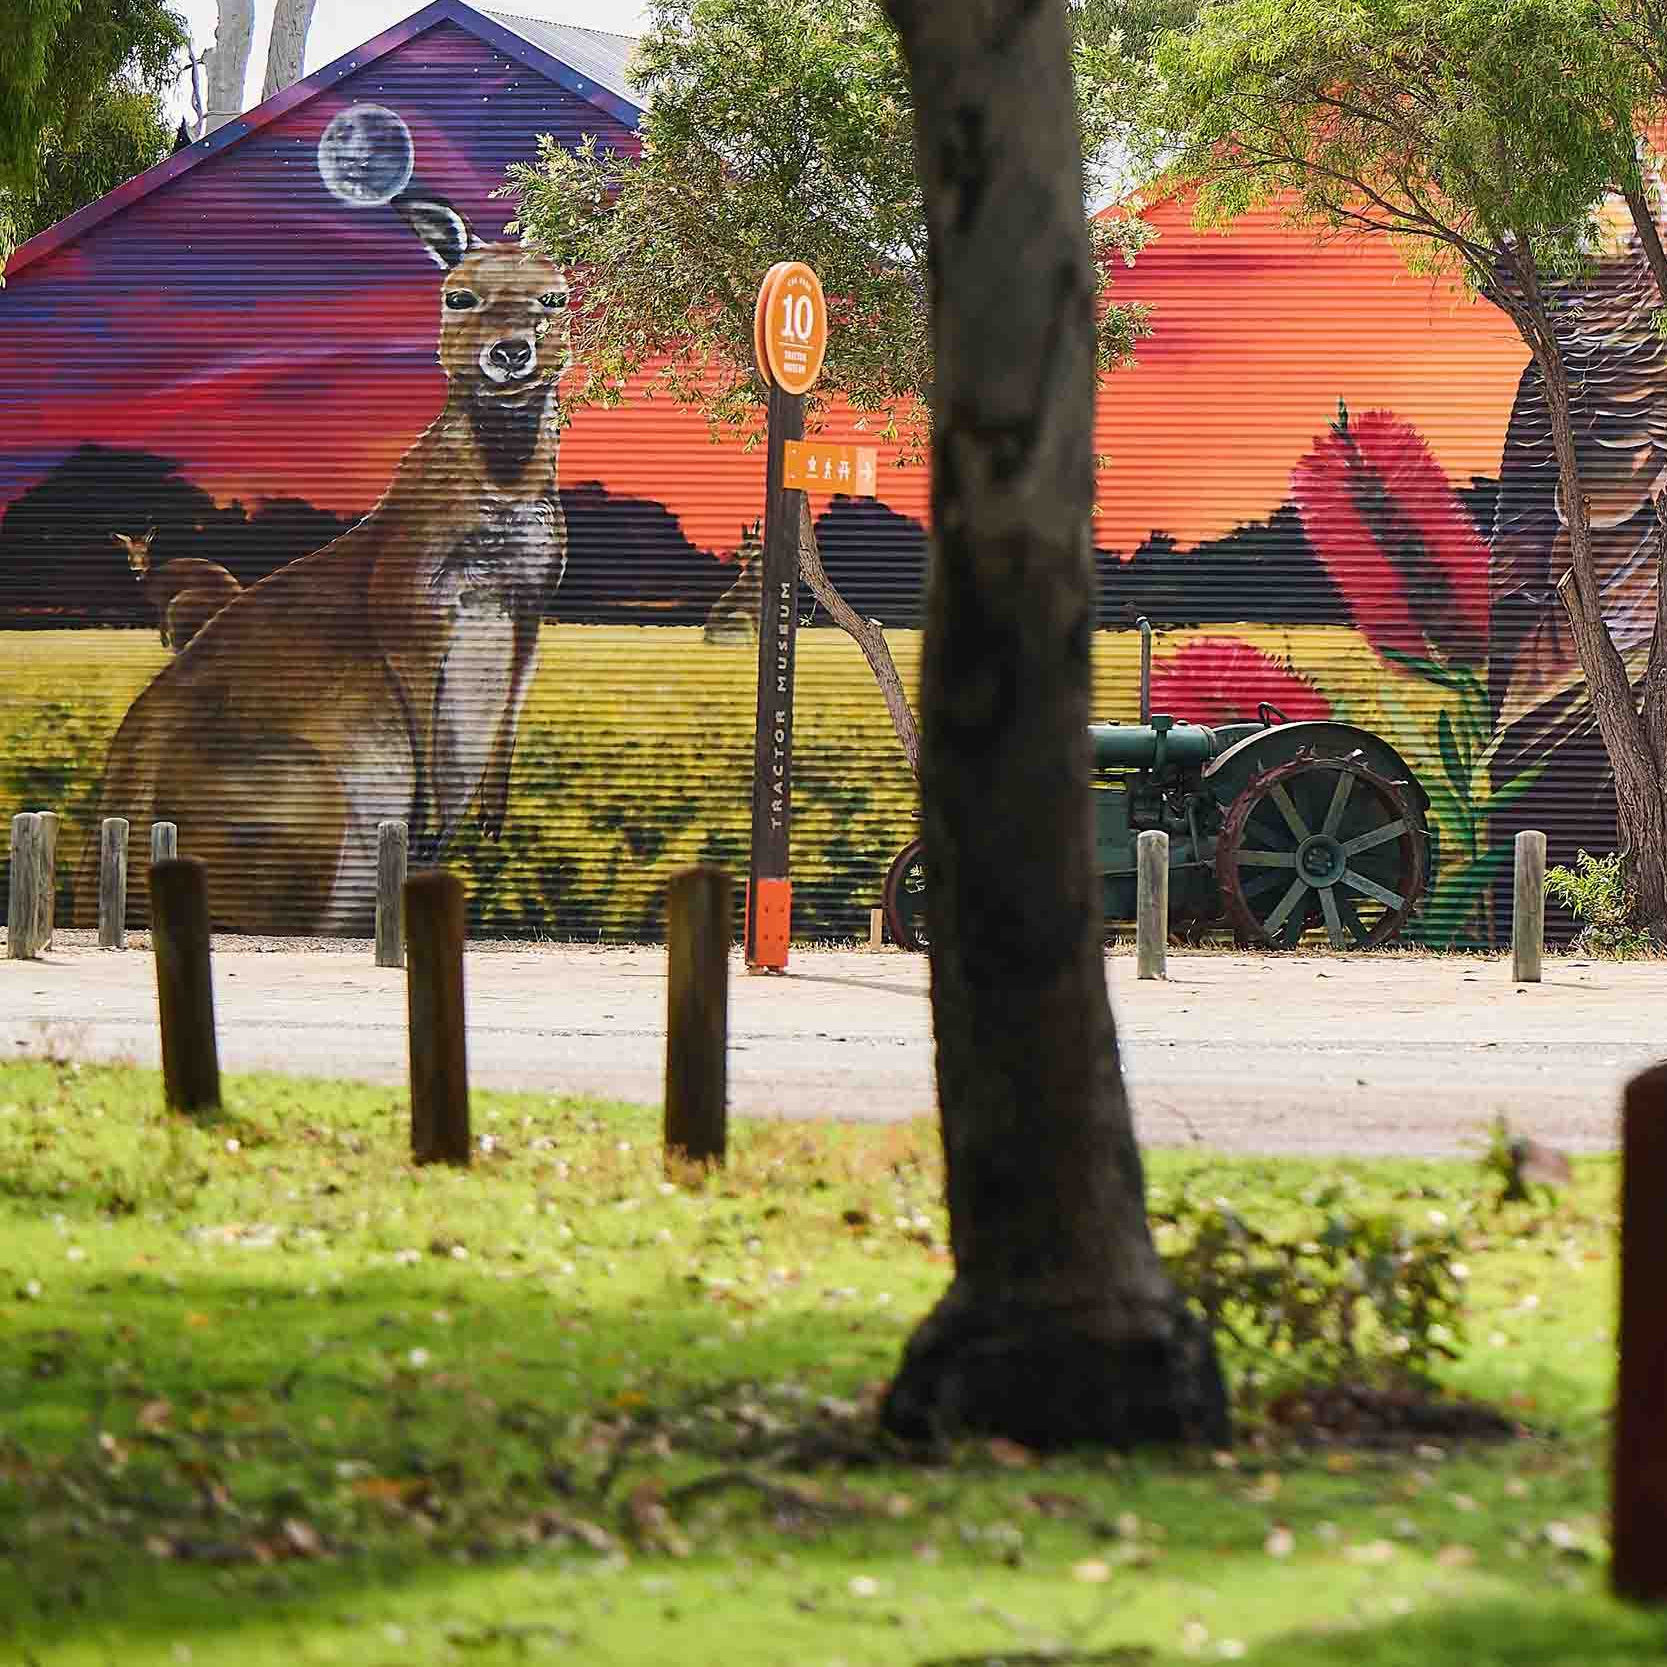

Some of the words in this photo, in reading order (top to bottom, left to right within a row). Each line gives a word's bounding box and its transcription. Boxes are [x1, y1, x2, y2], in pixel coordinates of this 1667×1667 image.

[780, 293, 814, 340] 10
[777, 582, 791, 692] MUSEUM
[771, 710, 785, 830] TRACTOR
